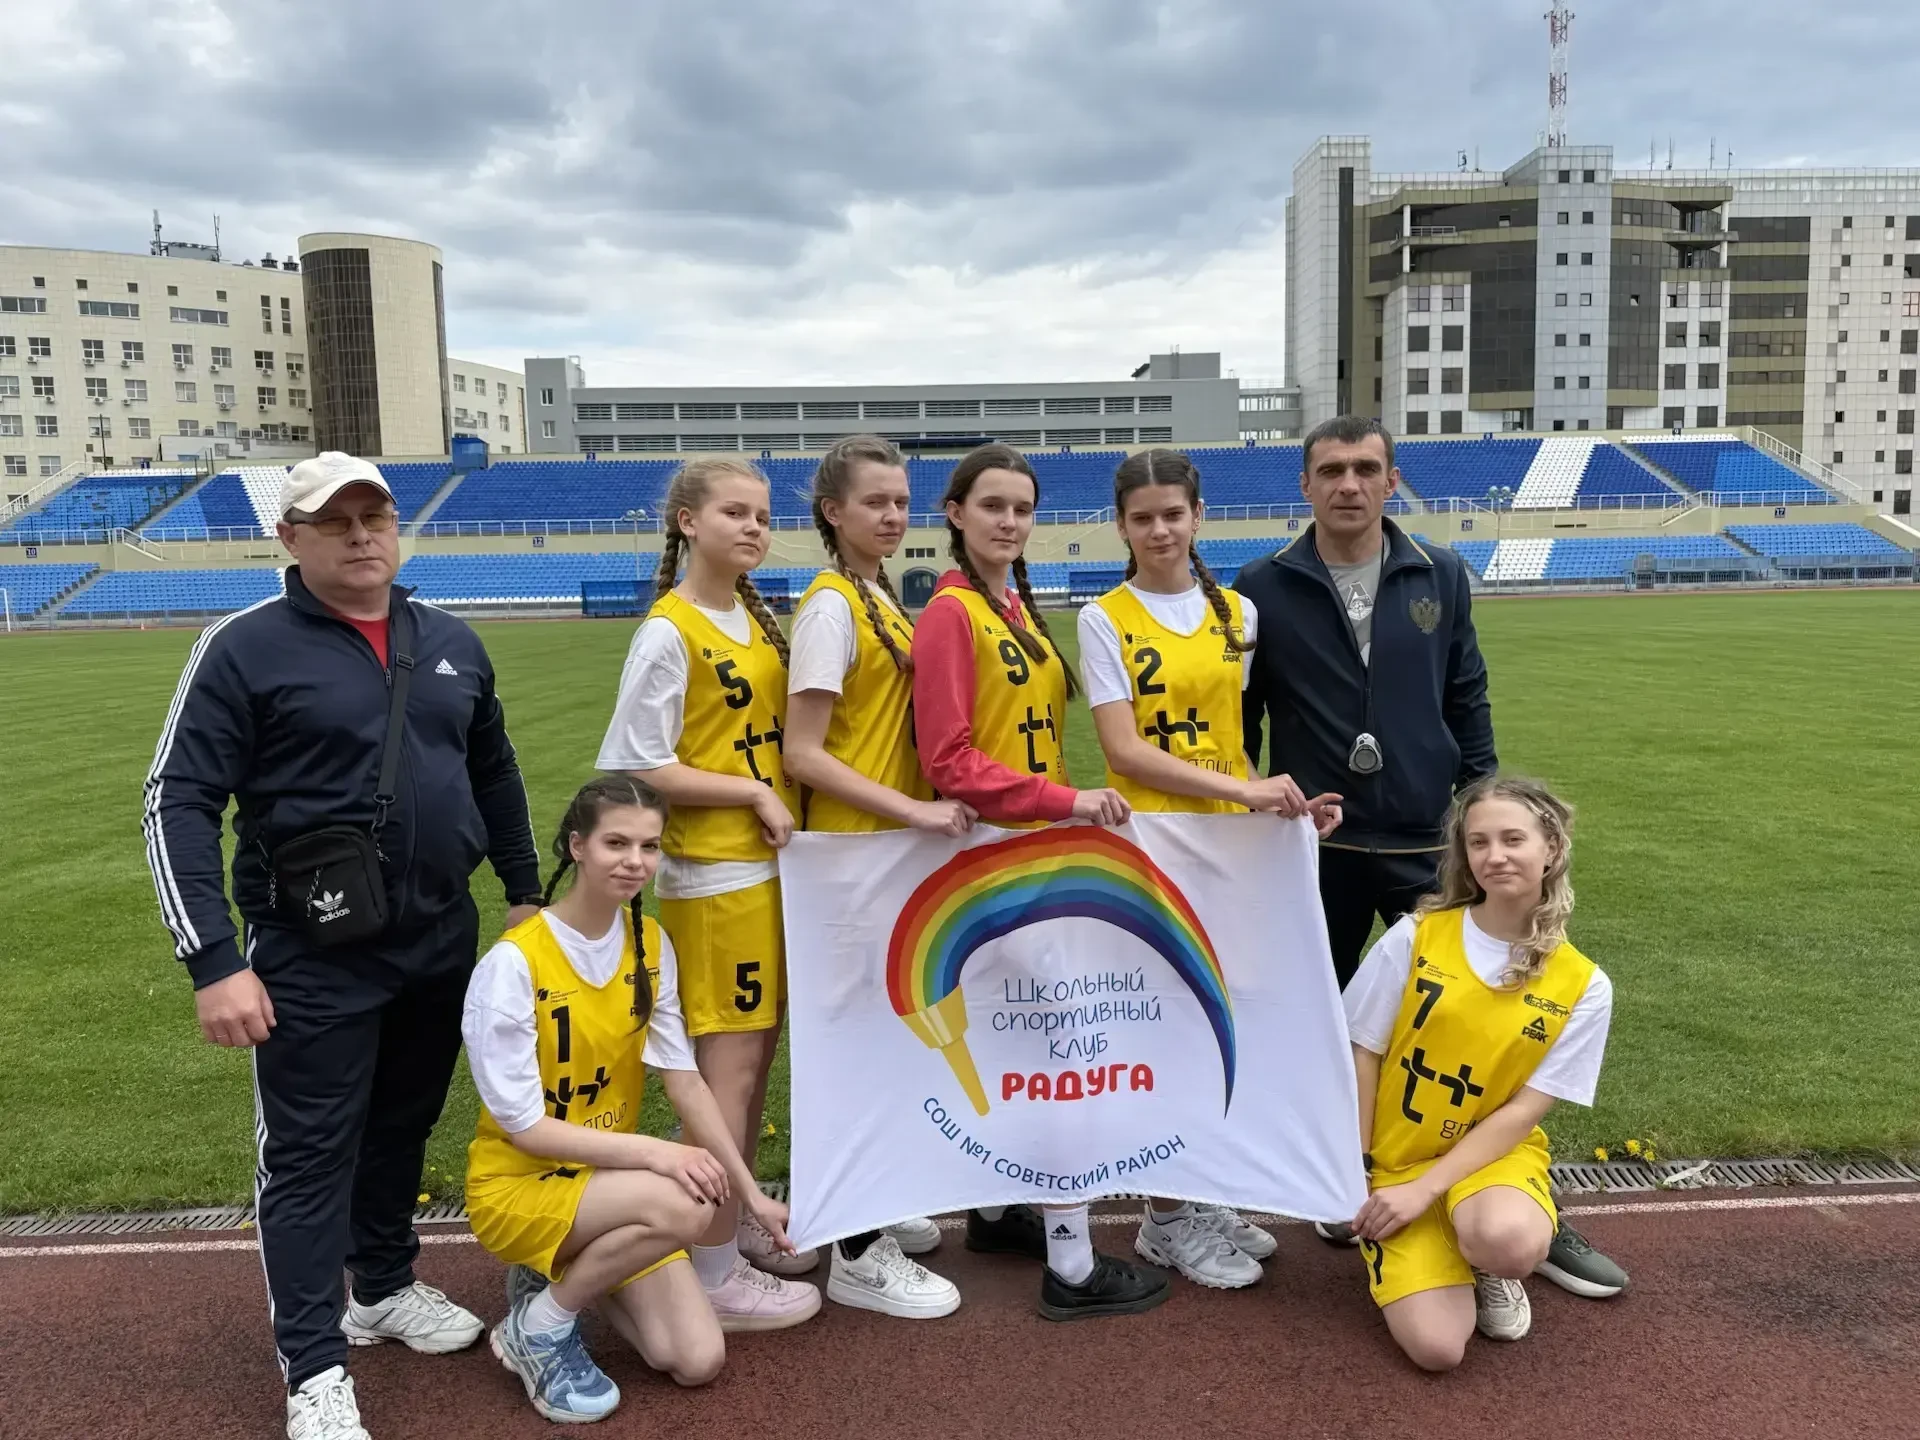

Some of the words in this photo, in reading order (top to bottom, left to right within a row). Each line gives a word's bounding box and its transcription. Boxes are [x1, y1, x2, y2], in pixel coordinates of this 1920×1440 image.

[435, 667, 458, 676] adidas
[715, 659, 753, 710] 5
[998, 639, 1030, 686] 9
[1134, 647, 1166, 695] 2
[318, 907, 351, 923] adidas
[735, 961, 763, 1012] 5
[1004, 966, 1145, 1003] Школьный
[1412, 977, 1445, 1030] 7
[551, 1004, 571, 1064] 1
[992, 995, 1162, 1036] спортивный
[1521, 1026, 1549, 1044] PEAK
[1002, 1063, 1154, 1101] РАДУГА
[923, 1097, 962, 1141] СОШ
[959, 1135, 992, 1165] №1
[994, 1158, 1109, 1191] СОВЕТСКИЙ
[1115, 1134, 1186, 1176] РАЙОН
[1050, 1233, 1077, 1241] adidas
